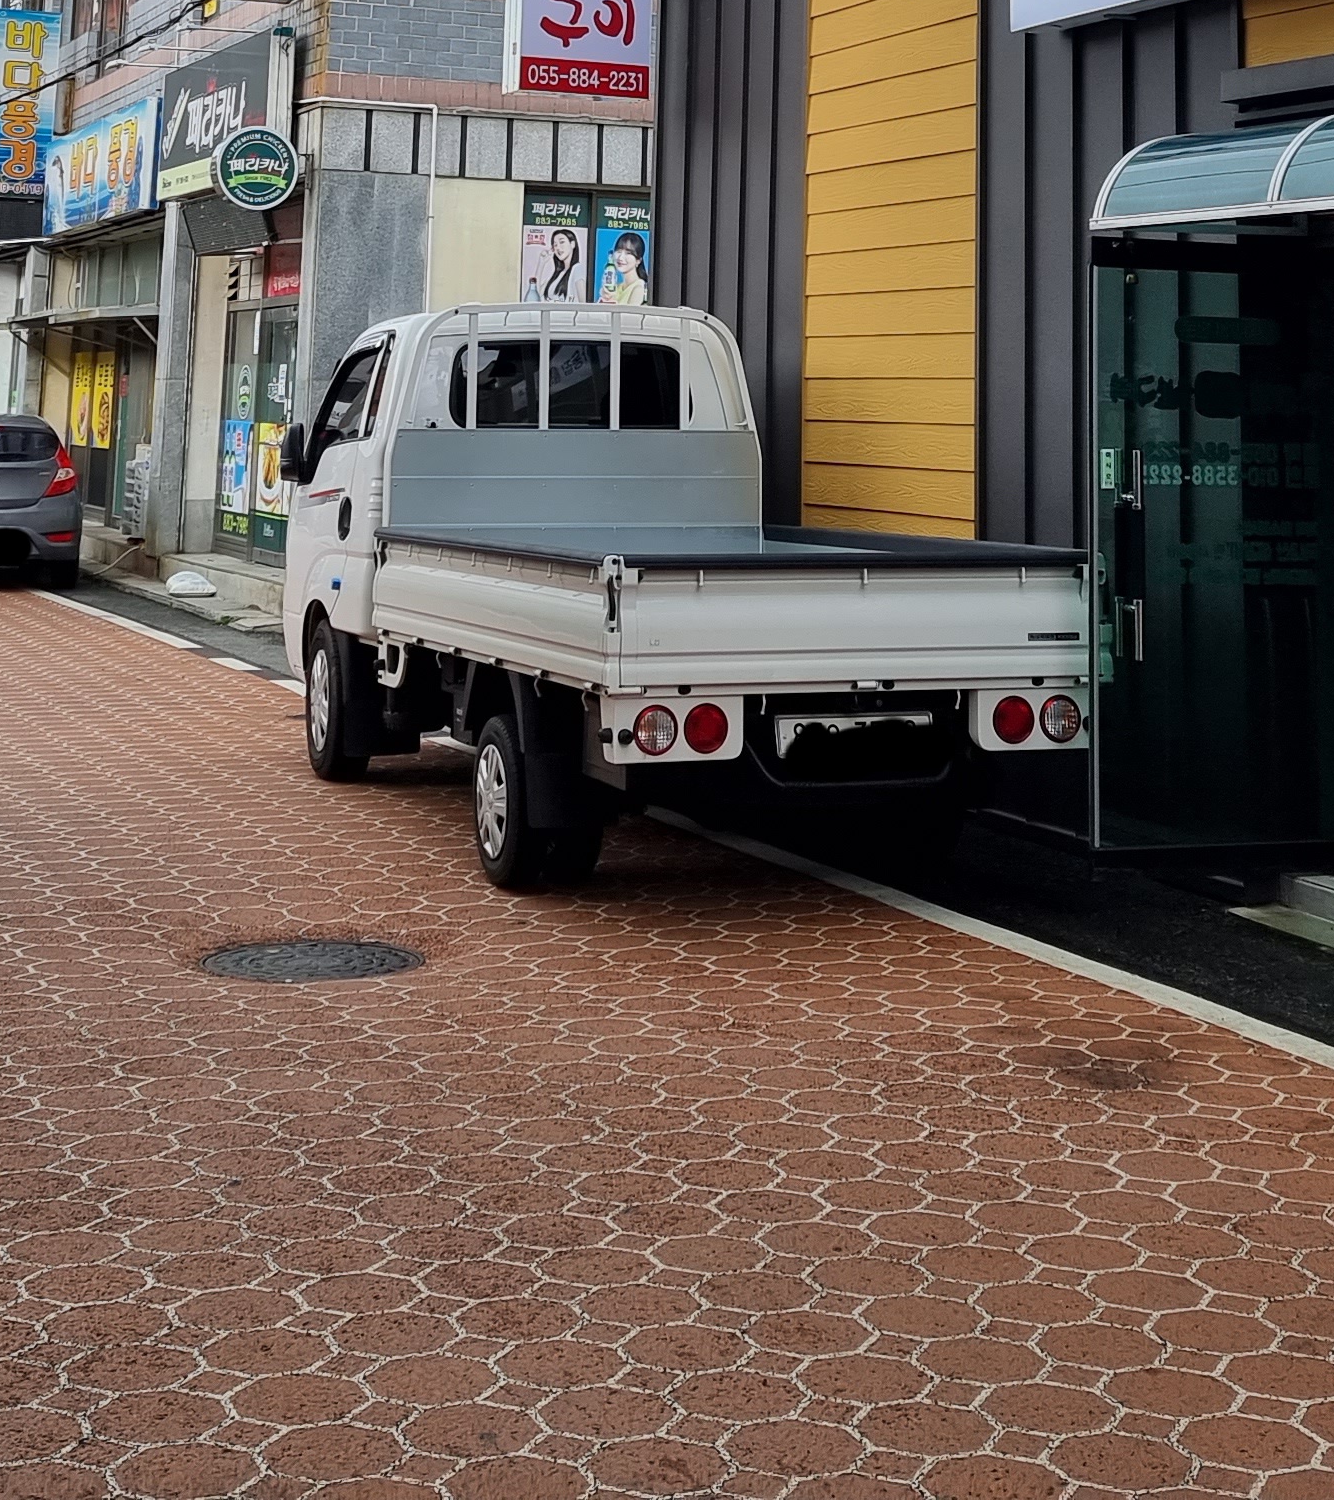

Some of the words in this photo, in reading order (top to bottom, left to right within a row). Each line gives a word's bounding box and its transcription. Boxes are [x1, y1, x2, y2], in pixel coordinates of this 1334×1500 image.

[526, 62, 644, 94] 055-884-2231
[186, 77, 247, 154] 페리카나
[69, 133, 99, 201] 바다
[107, 116, 138, 191] 풍경
[227, 157, 290, 176] 페리카나
[531, 202, 581, 217] 페리카나
